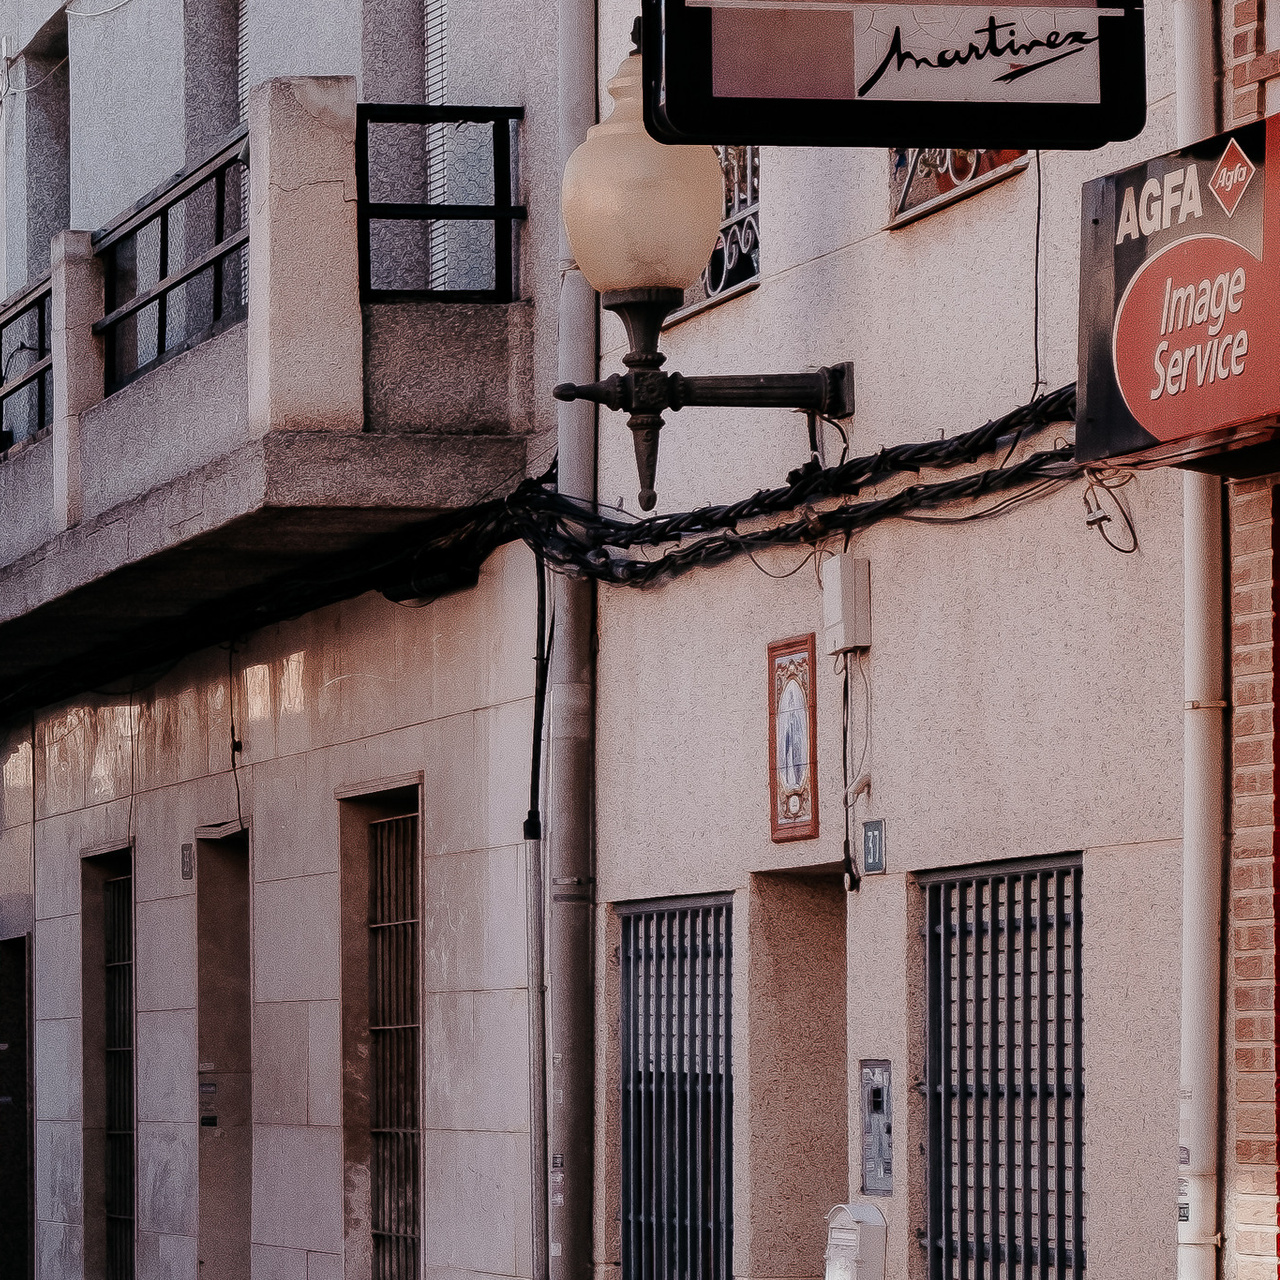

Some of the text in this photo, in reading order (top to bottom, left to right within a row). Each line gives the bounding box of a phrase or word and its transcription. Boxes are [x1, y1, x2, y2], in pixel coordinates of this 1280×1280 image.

[1116, 163, 1247, 245] AGFA Agfa
[1160, 267, 1246, 336] Image
[1150, 329, 1249, 401] Service
[867, 830, 880, 864] 37
